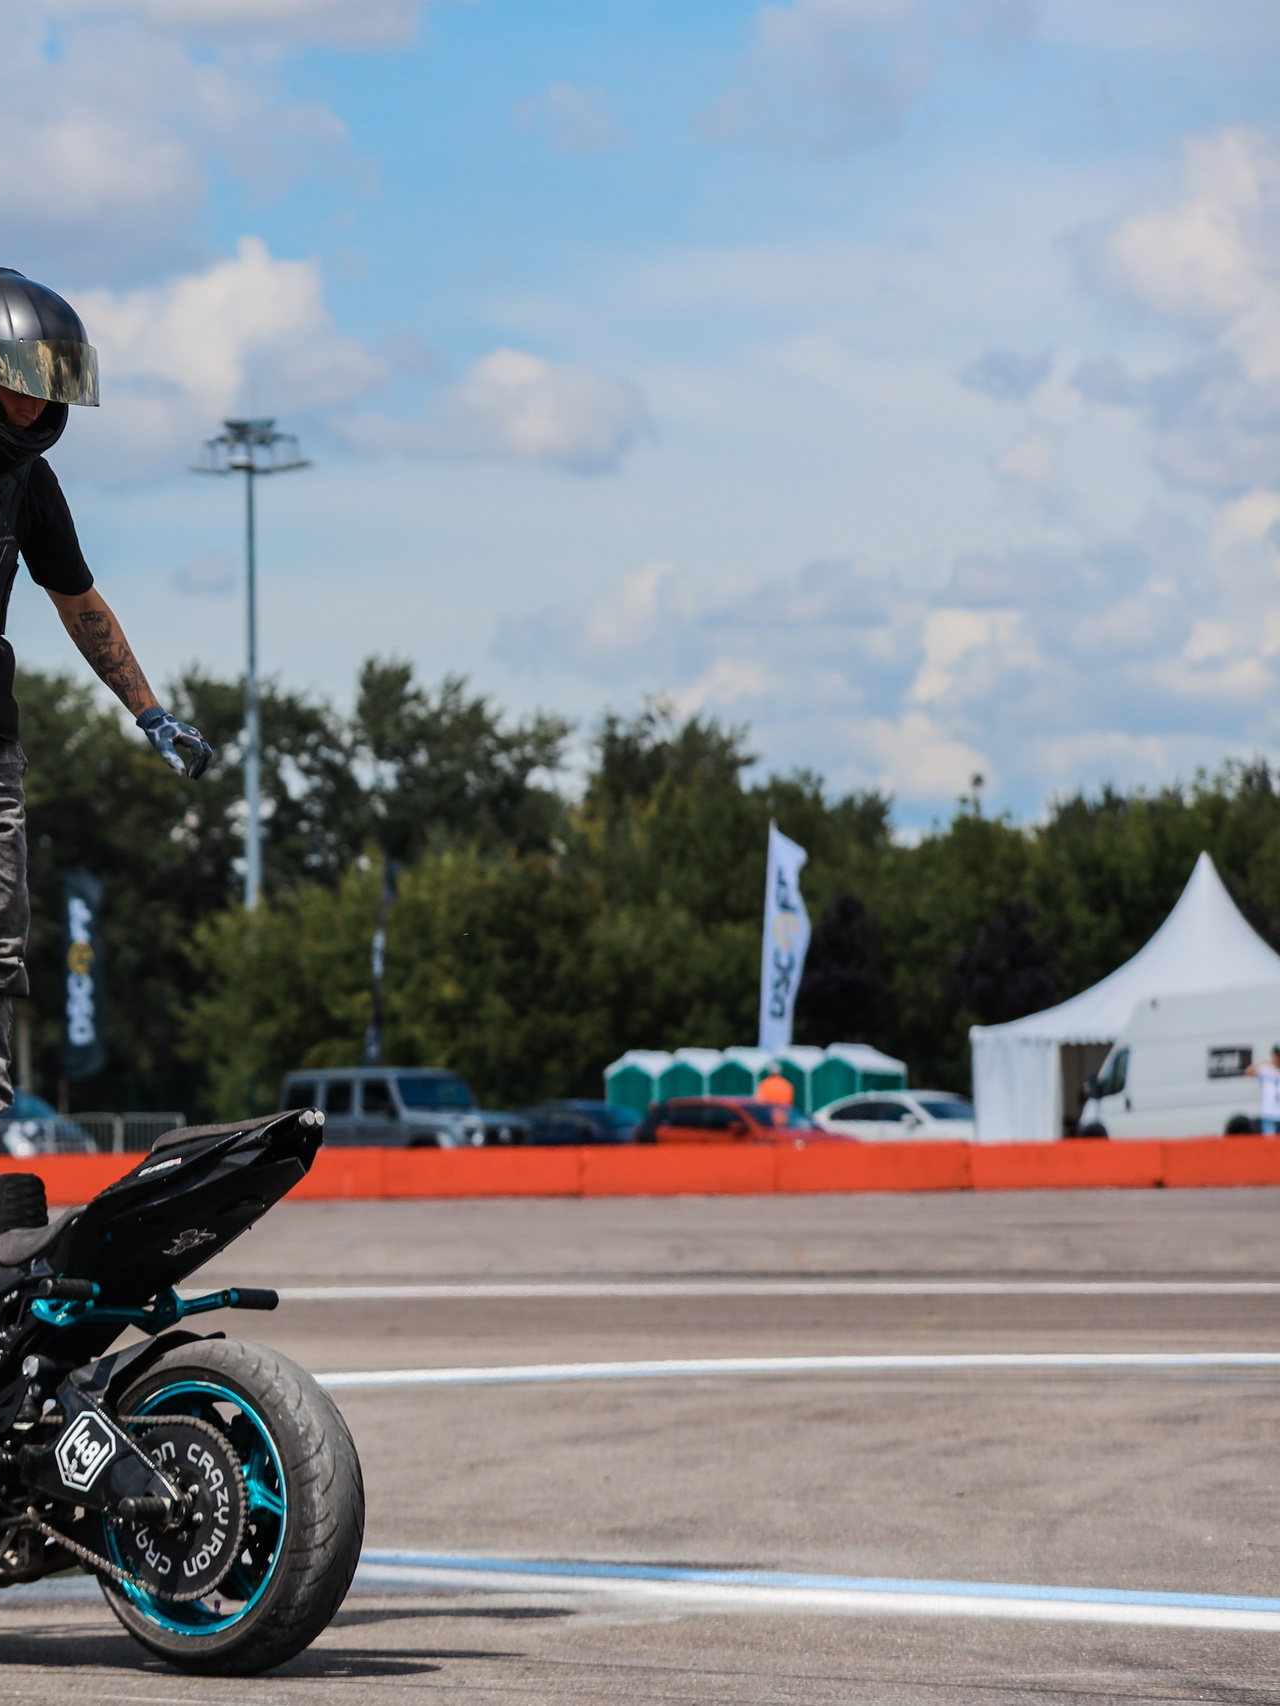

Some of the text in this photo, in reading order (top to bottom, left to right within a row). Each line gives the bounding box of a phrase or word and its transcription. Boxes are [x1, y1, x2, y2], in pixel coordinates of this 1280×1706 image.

[73, 1429, 101, 1468] 48
[182, 1442, 230, 1578] CRAZY IRON
